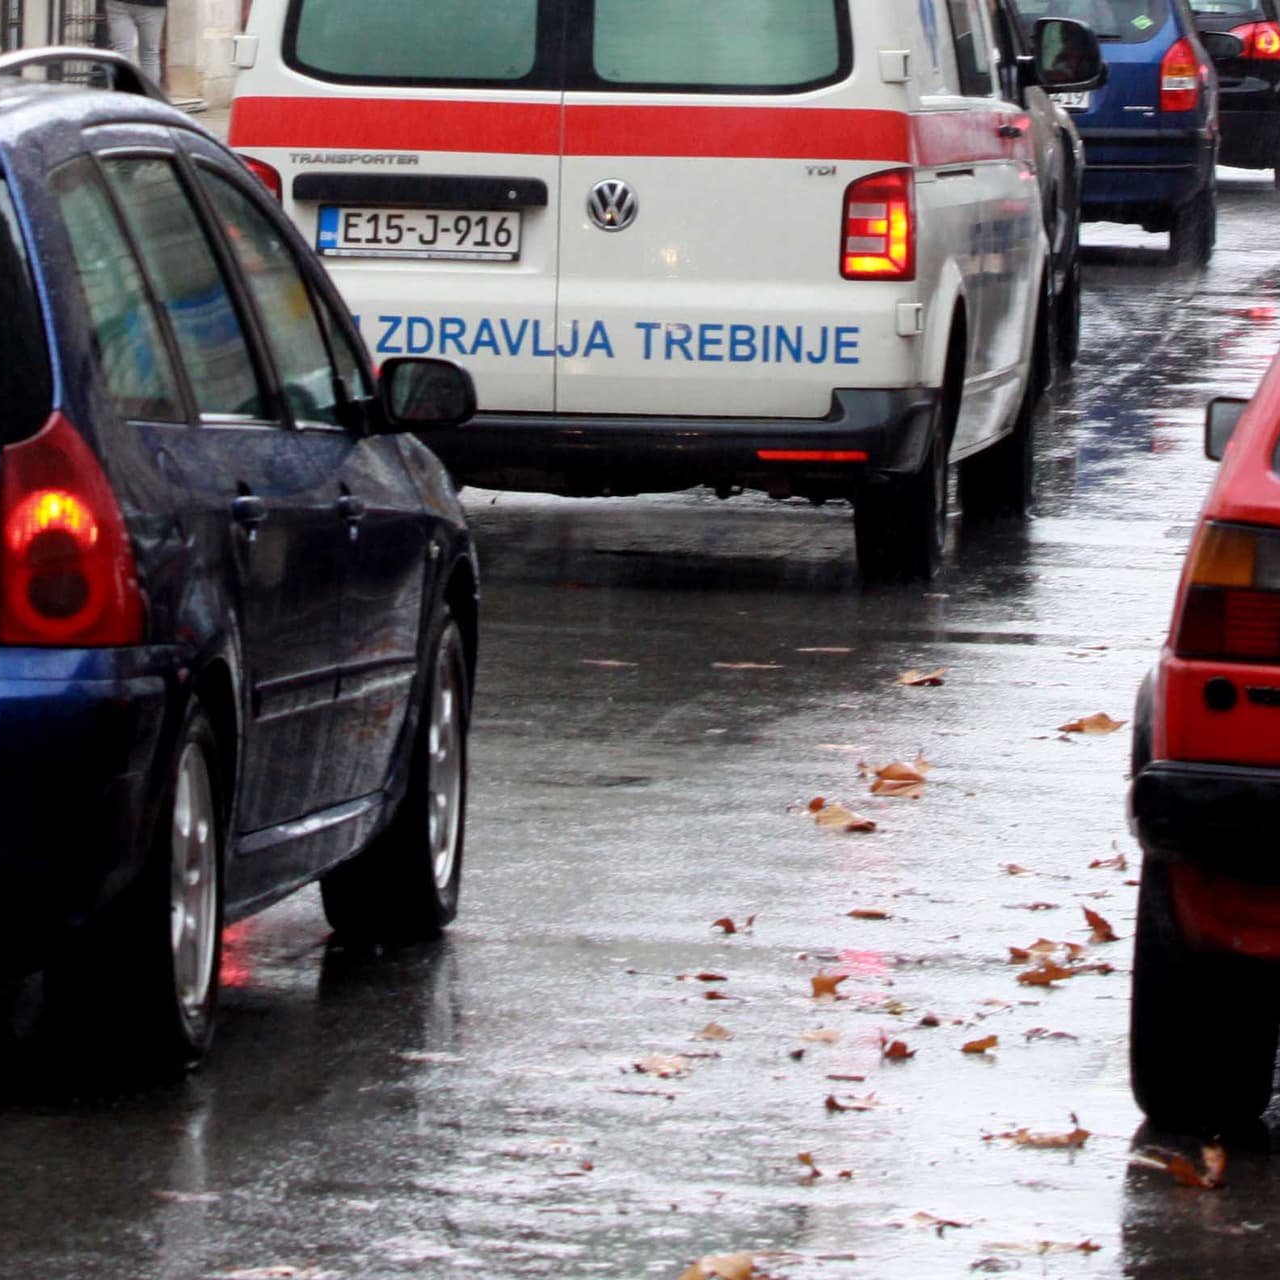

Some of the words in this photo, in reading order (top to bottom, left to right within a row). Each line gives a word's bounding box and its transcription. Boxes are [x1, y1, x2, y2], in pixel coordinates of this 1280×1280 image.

[289, 152, 420, 166] TRANSPORTER
[805, 165, 838, 176] TDI
[342, 212, 513, 248] E15-J-916
[375, 315, 615, 359] ZDRAVLJA
[635, 320, 860, 365] TREBINJE
